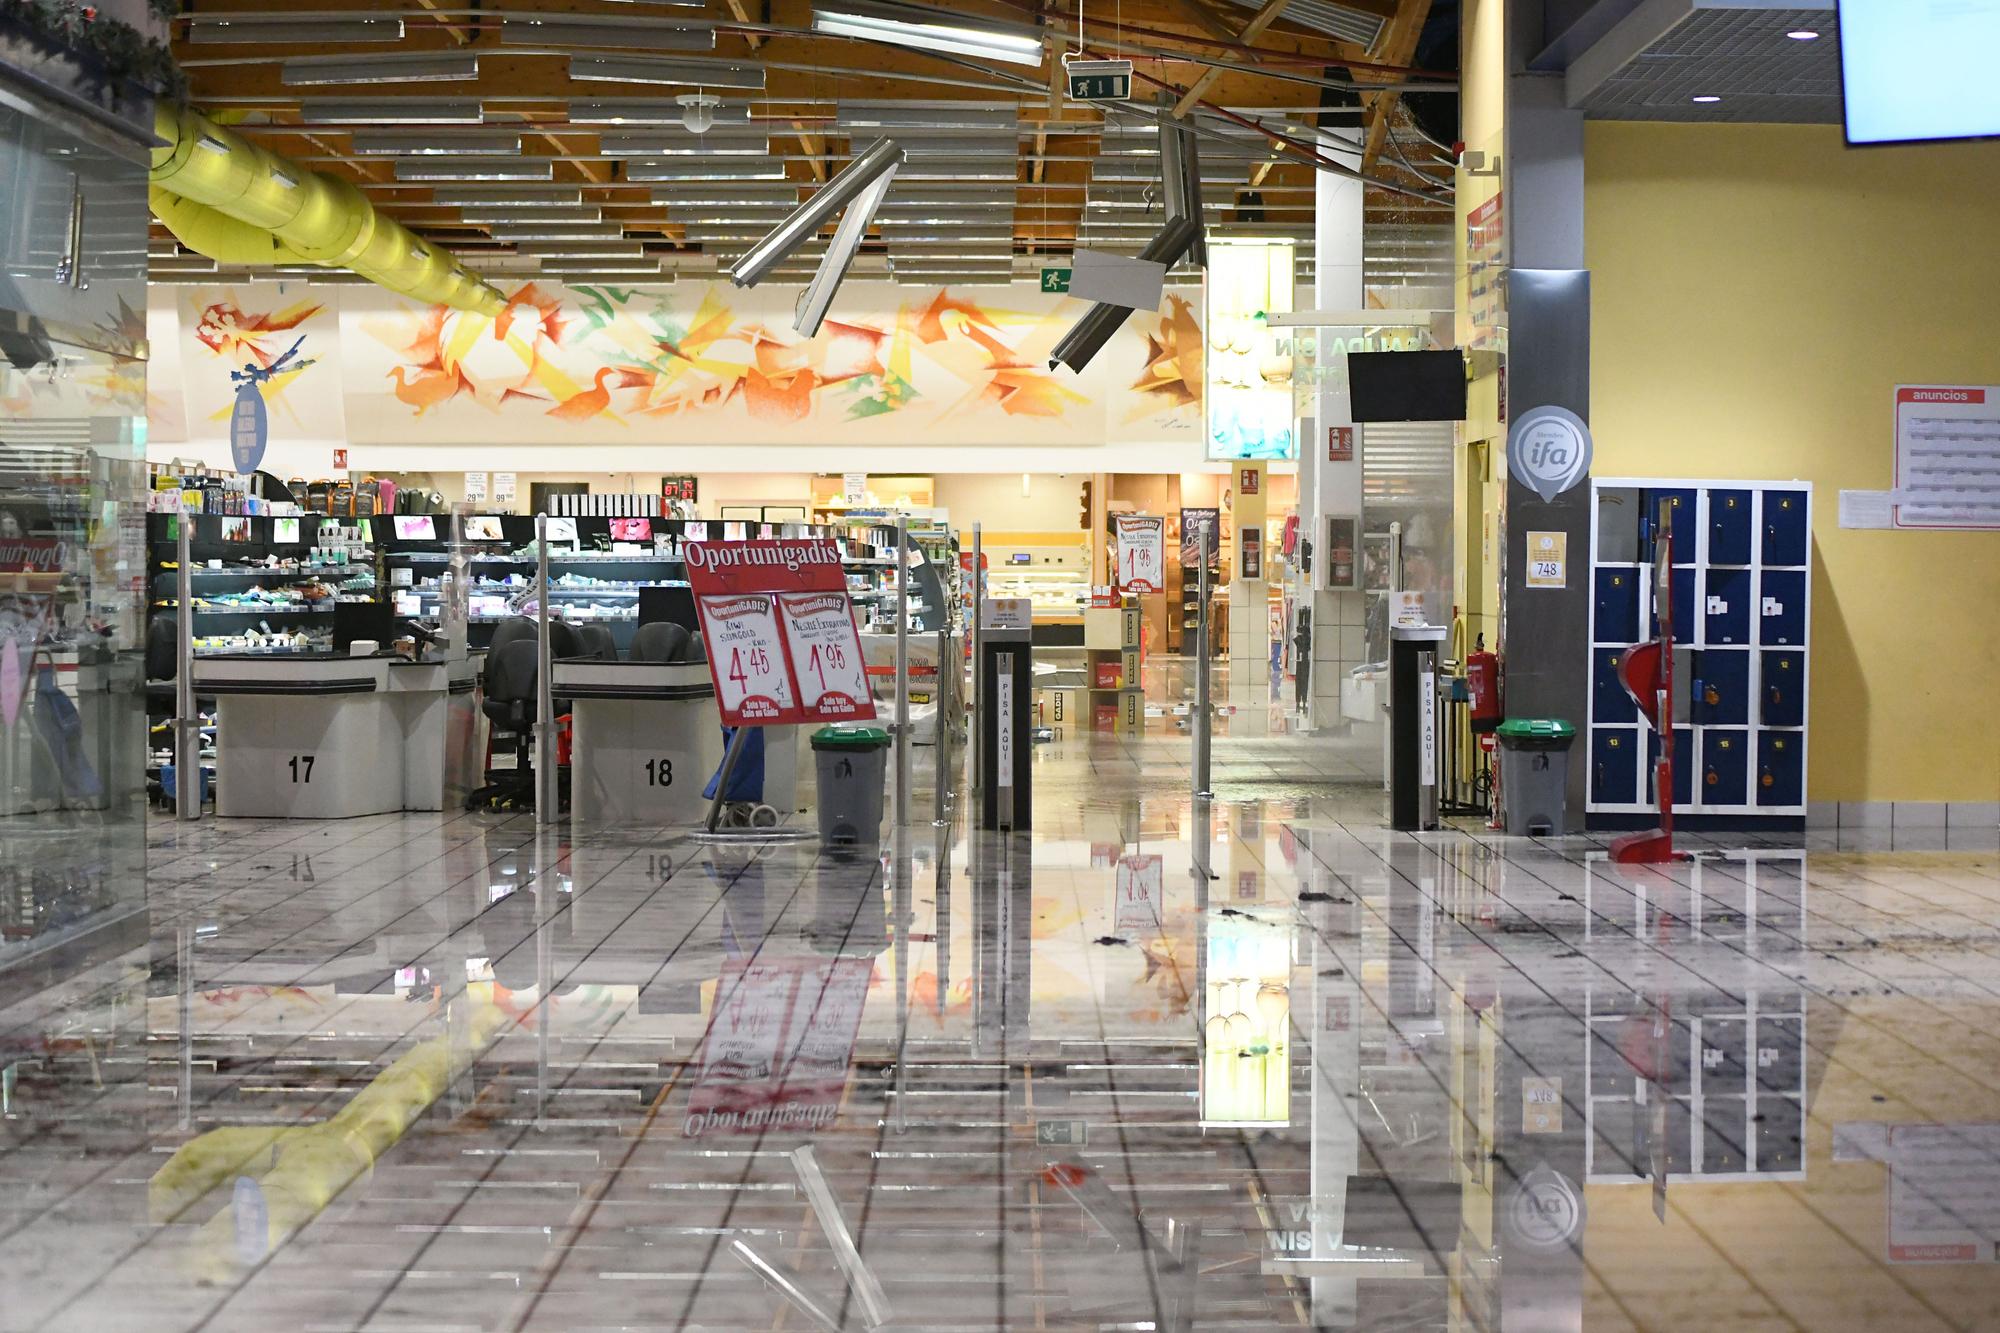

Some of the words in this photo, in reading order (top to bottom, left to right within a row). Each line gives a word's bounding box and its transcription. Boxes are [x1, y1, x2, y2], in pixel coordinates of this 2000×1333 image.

[1913, 389, 1968, 401] anuncios
[1531, 441, 1567, 468] ifa
[685, 540, 838, 573] Oportunigadis
[1537, 563, 1557, 576] 748
[711, 600, 766, 616] OportuniGADIS
[788, 598, 842, 614] OportuniGADIS
[289, 756, 314, 783] 17
[646, 759, 672, 786] 18
